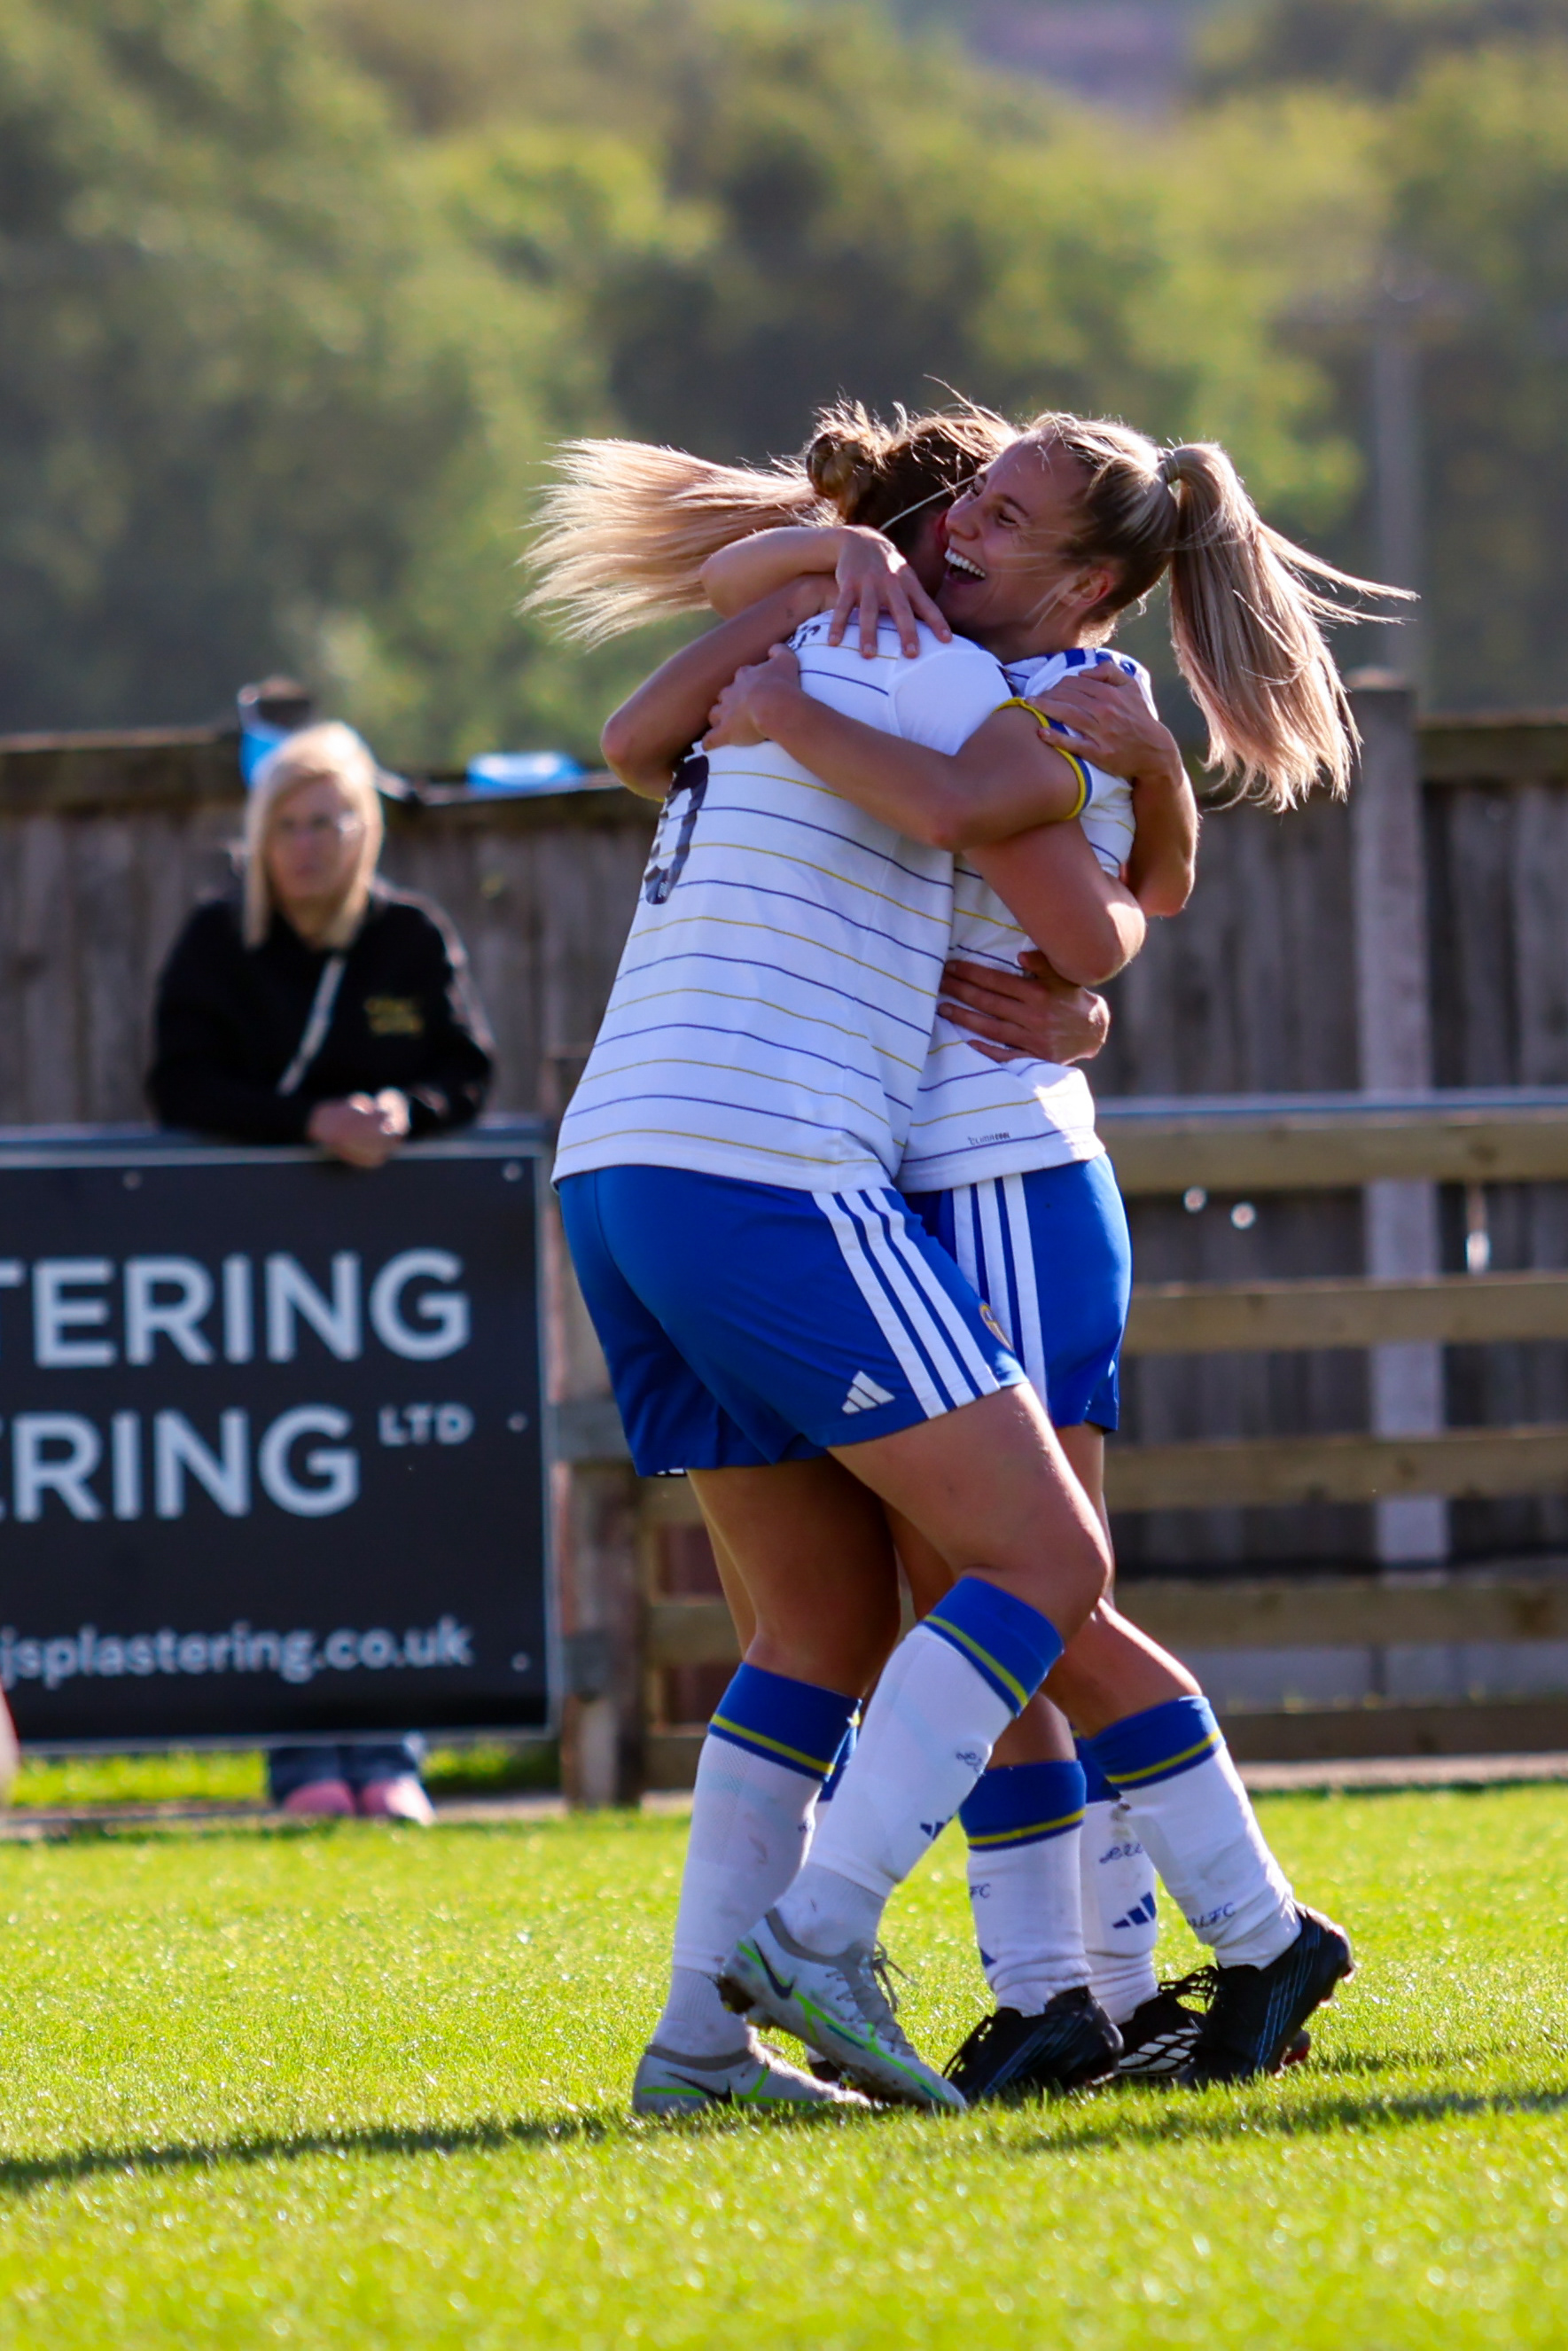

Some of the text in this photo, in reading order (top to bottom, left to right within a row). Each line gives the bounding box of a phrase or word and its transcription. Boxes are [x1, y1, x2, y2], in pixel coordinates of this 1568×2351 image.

[0, 1249, 470, 1368] ERING
[0, 1402, 474, 1521] RING LTD
[0, 1615, 473, 1690] jsplastering.co.uk
